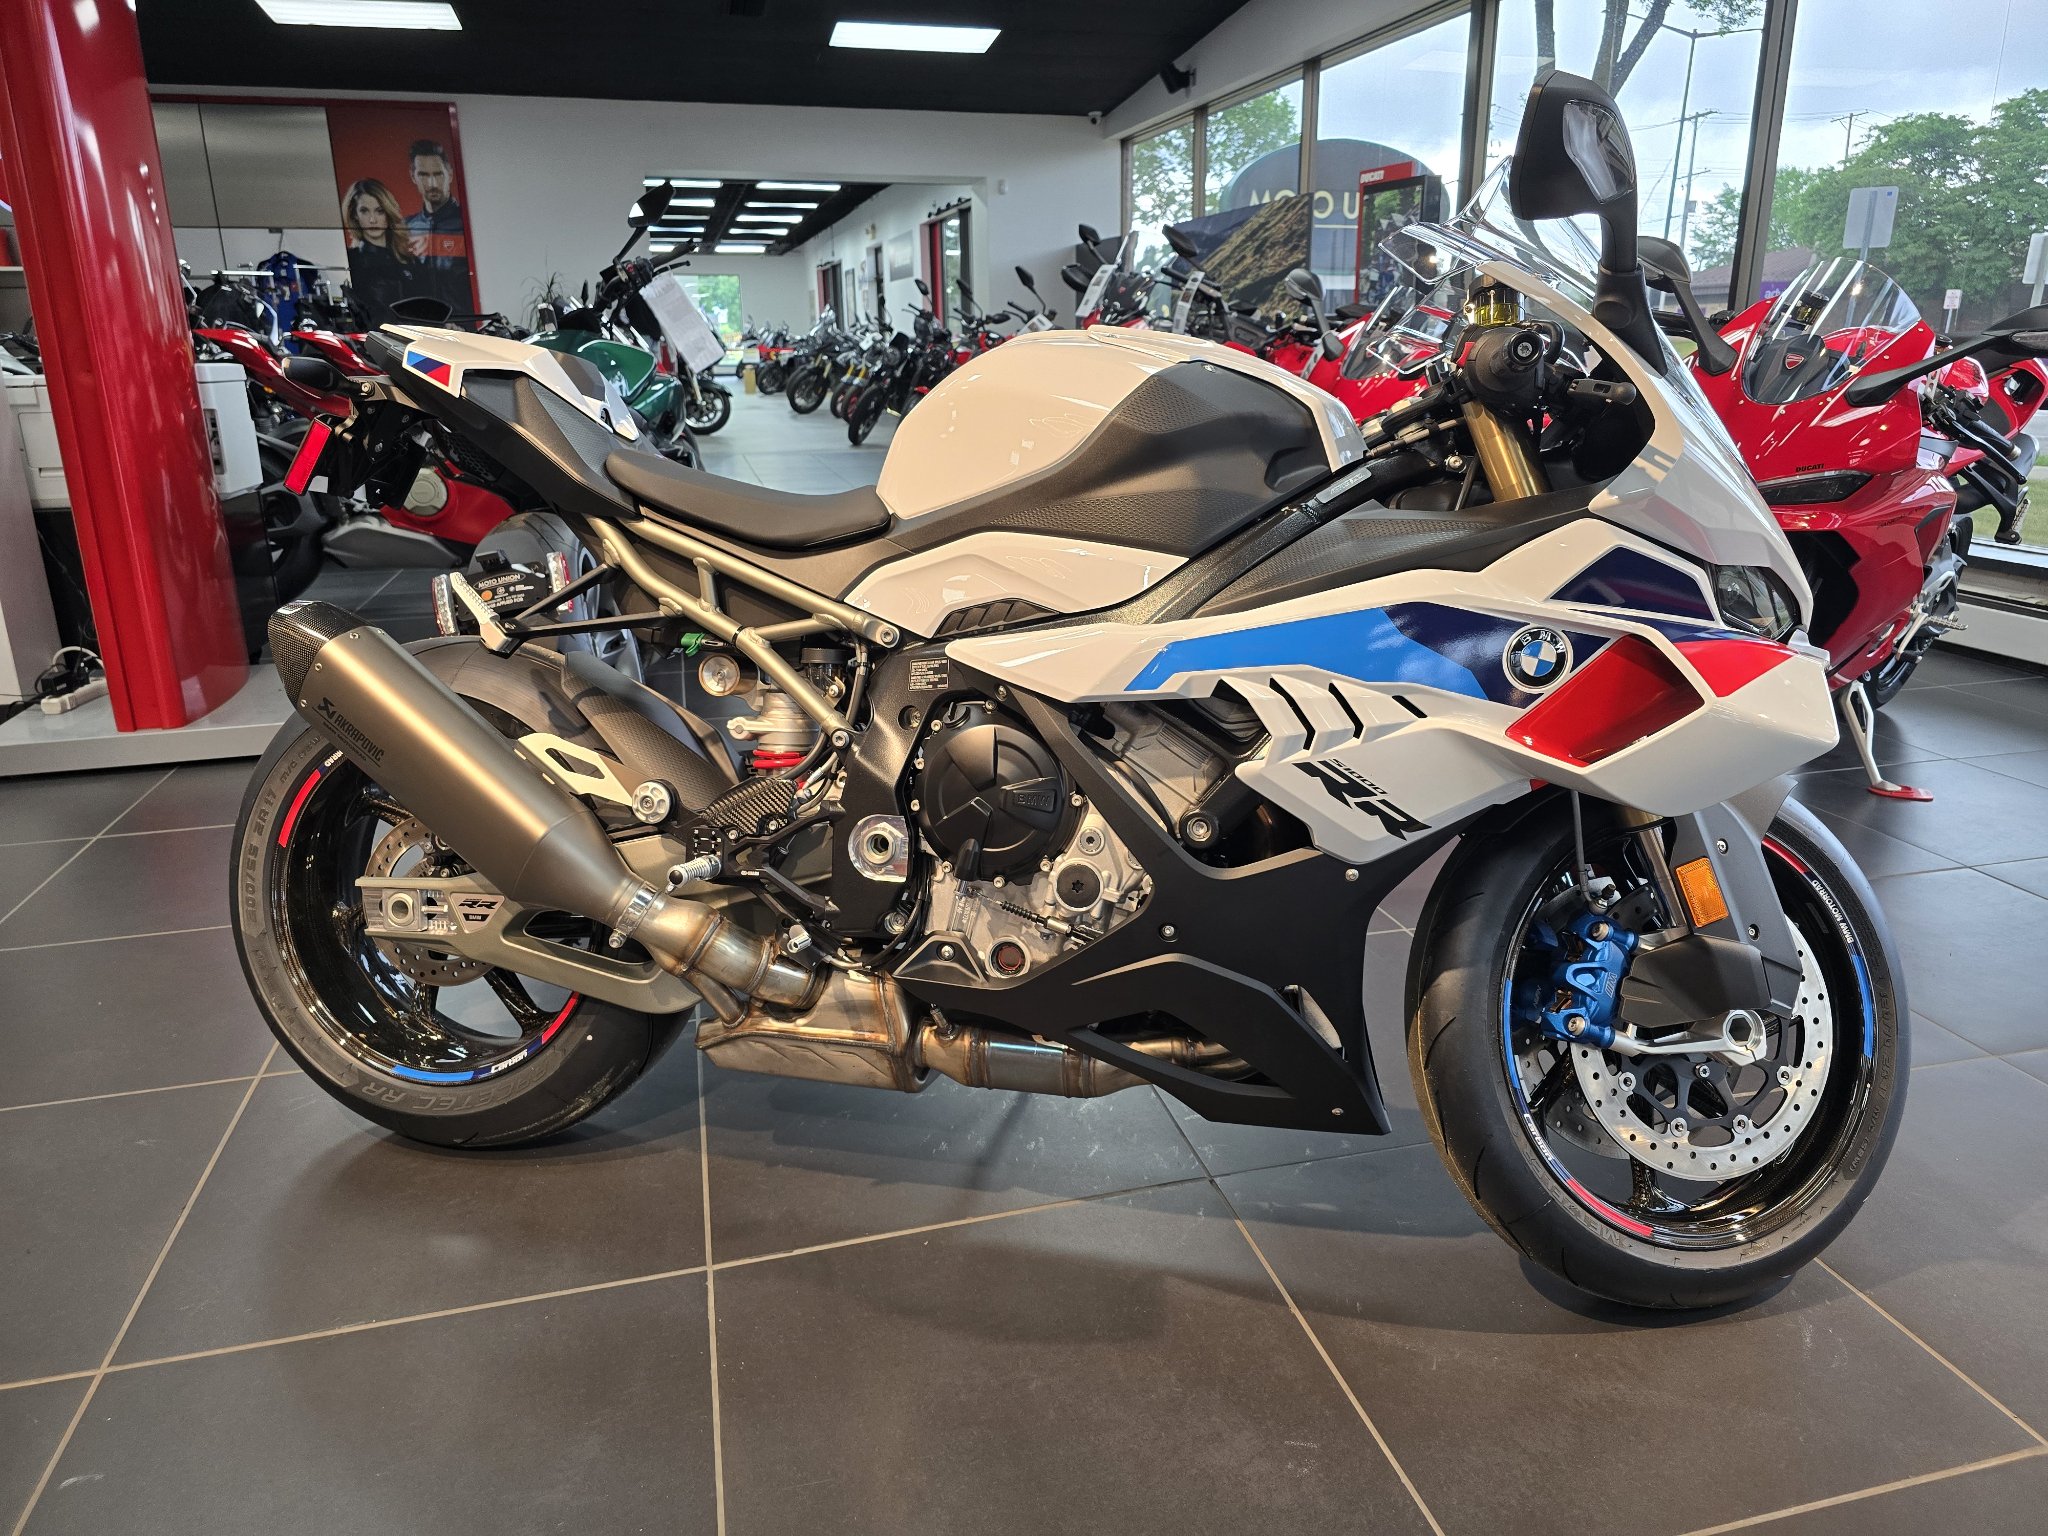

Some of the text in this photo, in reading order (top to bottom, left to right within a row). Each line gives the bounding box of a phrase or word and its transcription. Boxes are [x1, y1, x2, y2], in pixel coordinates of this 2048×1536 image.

[1360, 170, 1384, 183] DUCATI
[1795, 464, 1824, 473] DUCATI
[478, 573, 521, 589] MOTO UNION
[1520, 630, 1566, 654] BMW
[1328, 758, 1389, 795] S1000
[1016, 794, 1051, 807] BMW
[1291, 759, 1433, 841] RR
[243, 842, 260, 924] 200/55
[458, 900, 499, 910] RR
[1811, 879, 1855, 944] BMW MOTORRAD
[361, 1081, 406, 1103] RR
